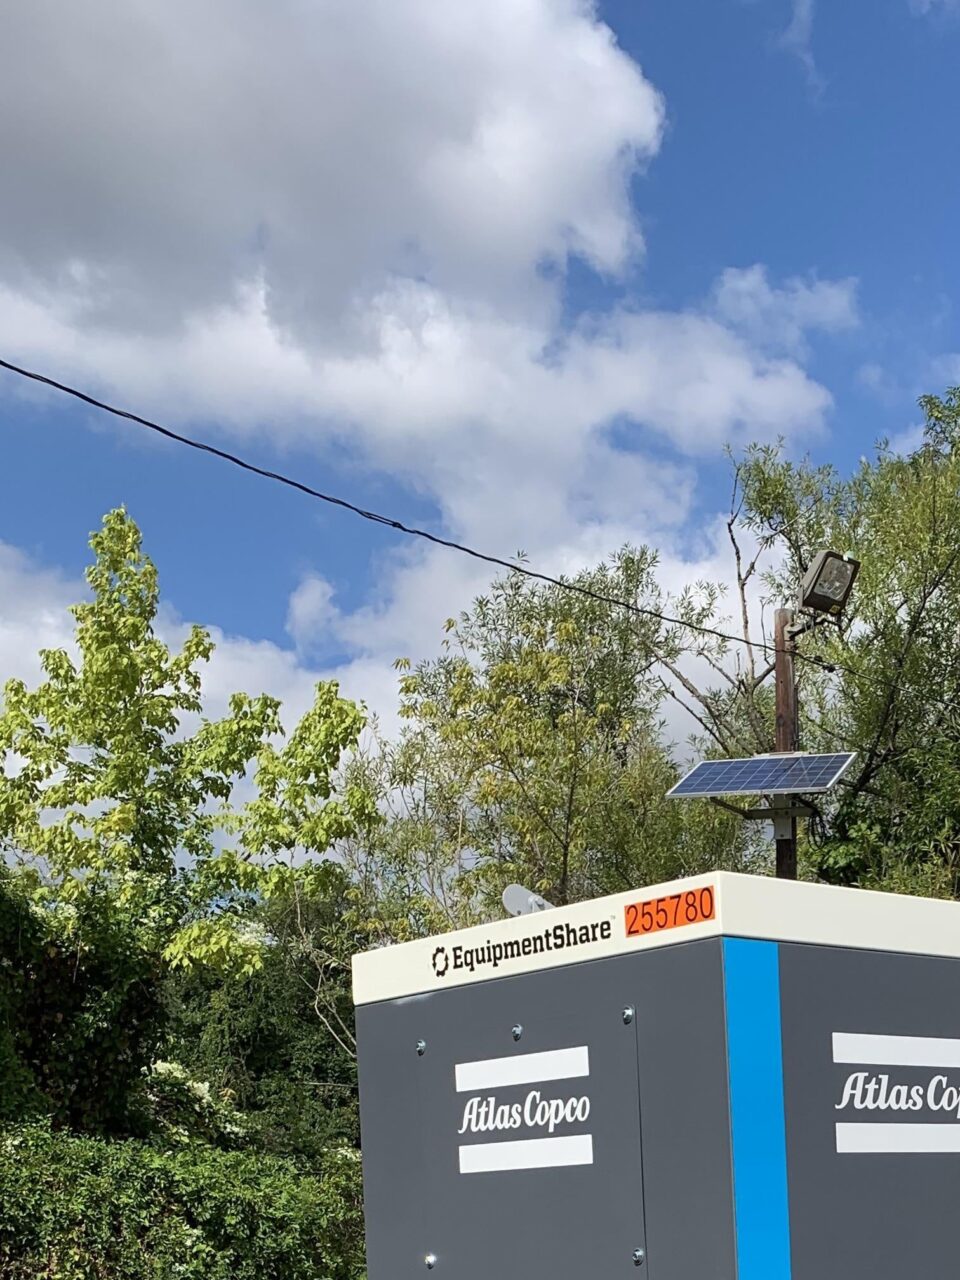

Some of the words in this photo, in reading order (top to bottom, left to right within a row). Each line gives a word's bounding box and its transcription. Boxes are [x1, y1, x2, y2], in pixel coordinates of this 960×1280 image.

[626, 887, 713, 935] 255780
[452, 919, 612, 972] EquipmentShare
[458, 1097, 522, 1134] Atlas
[523, 1090, 590, 1132] Copco
[835, 1072, 924, 1110] Atlas
